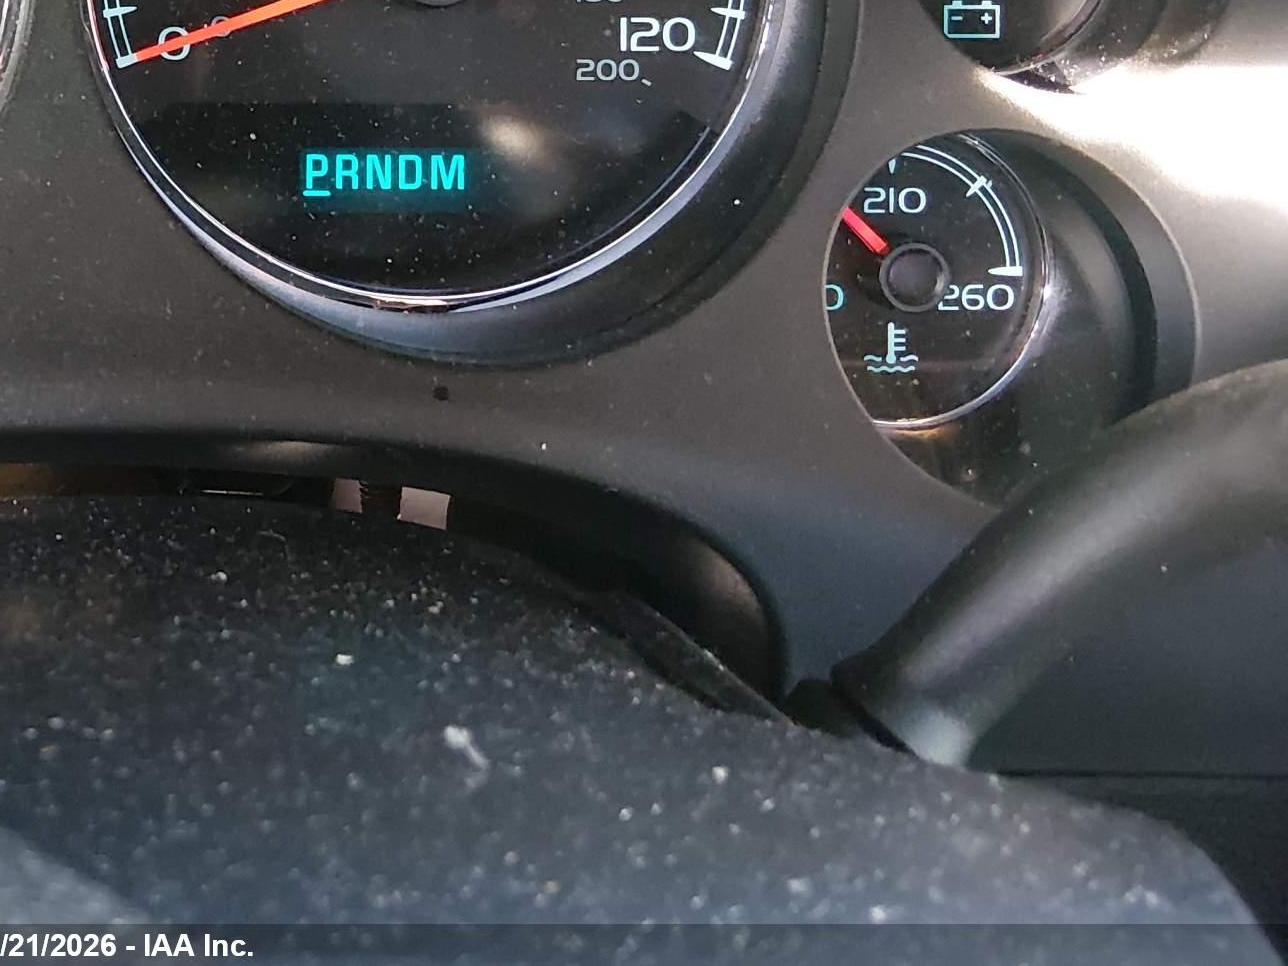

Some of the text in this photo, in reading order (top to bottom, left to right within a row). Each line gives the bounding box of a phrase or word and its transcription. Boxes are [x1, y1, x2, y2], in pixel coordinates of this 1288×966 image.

[620, 17, 695, 51] 120
[577, 59, 639, 80] 200
[302, 153, 464, 196] PRNDM
[864, 188, 926, 213] 210
[938, 284, 1014, 310] 260
